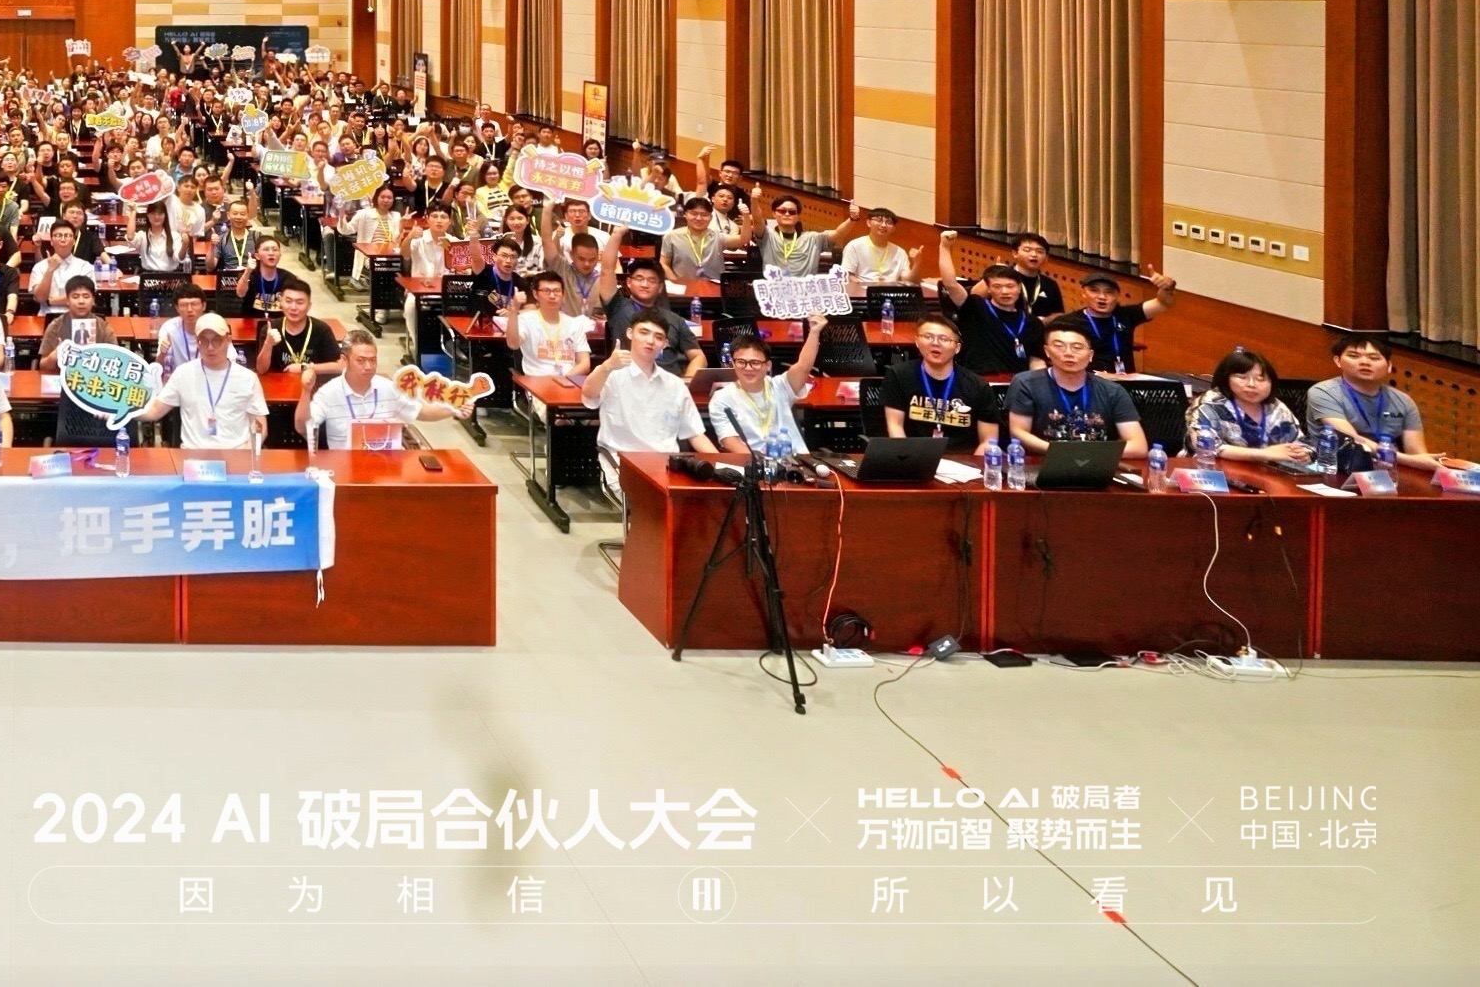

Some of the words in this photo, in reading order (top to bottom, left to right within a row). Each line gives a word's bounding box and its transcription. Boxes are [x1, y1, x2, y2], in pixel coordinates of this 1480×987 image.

[533, 158, 586, 179] 持之以恒
[530, 171, 583, 192] 永不言弃
[600, 203, 664, 229] 颜值担当
[757, 277, 841, 298] 用行动打破僵局
[775, 295, 847, 314] 创造无限可能
[61, 344, 145, 384] 行动破局
[65, 371, 149, 408] 未来可期
[399, 370, 473, 409] 我能行
